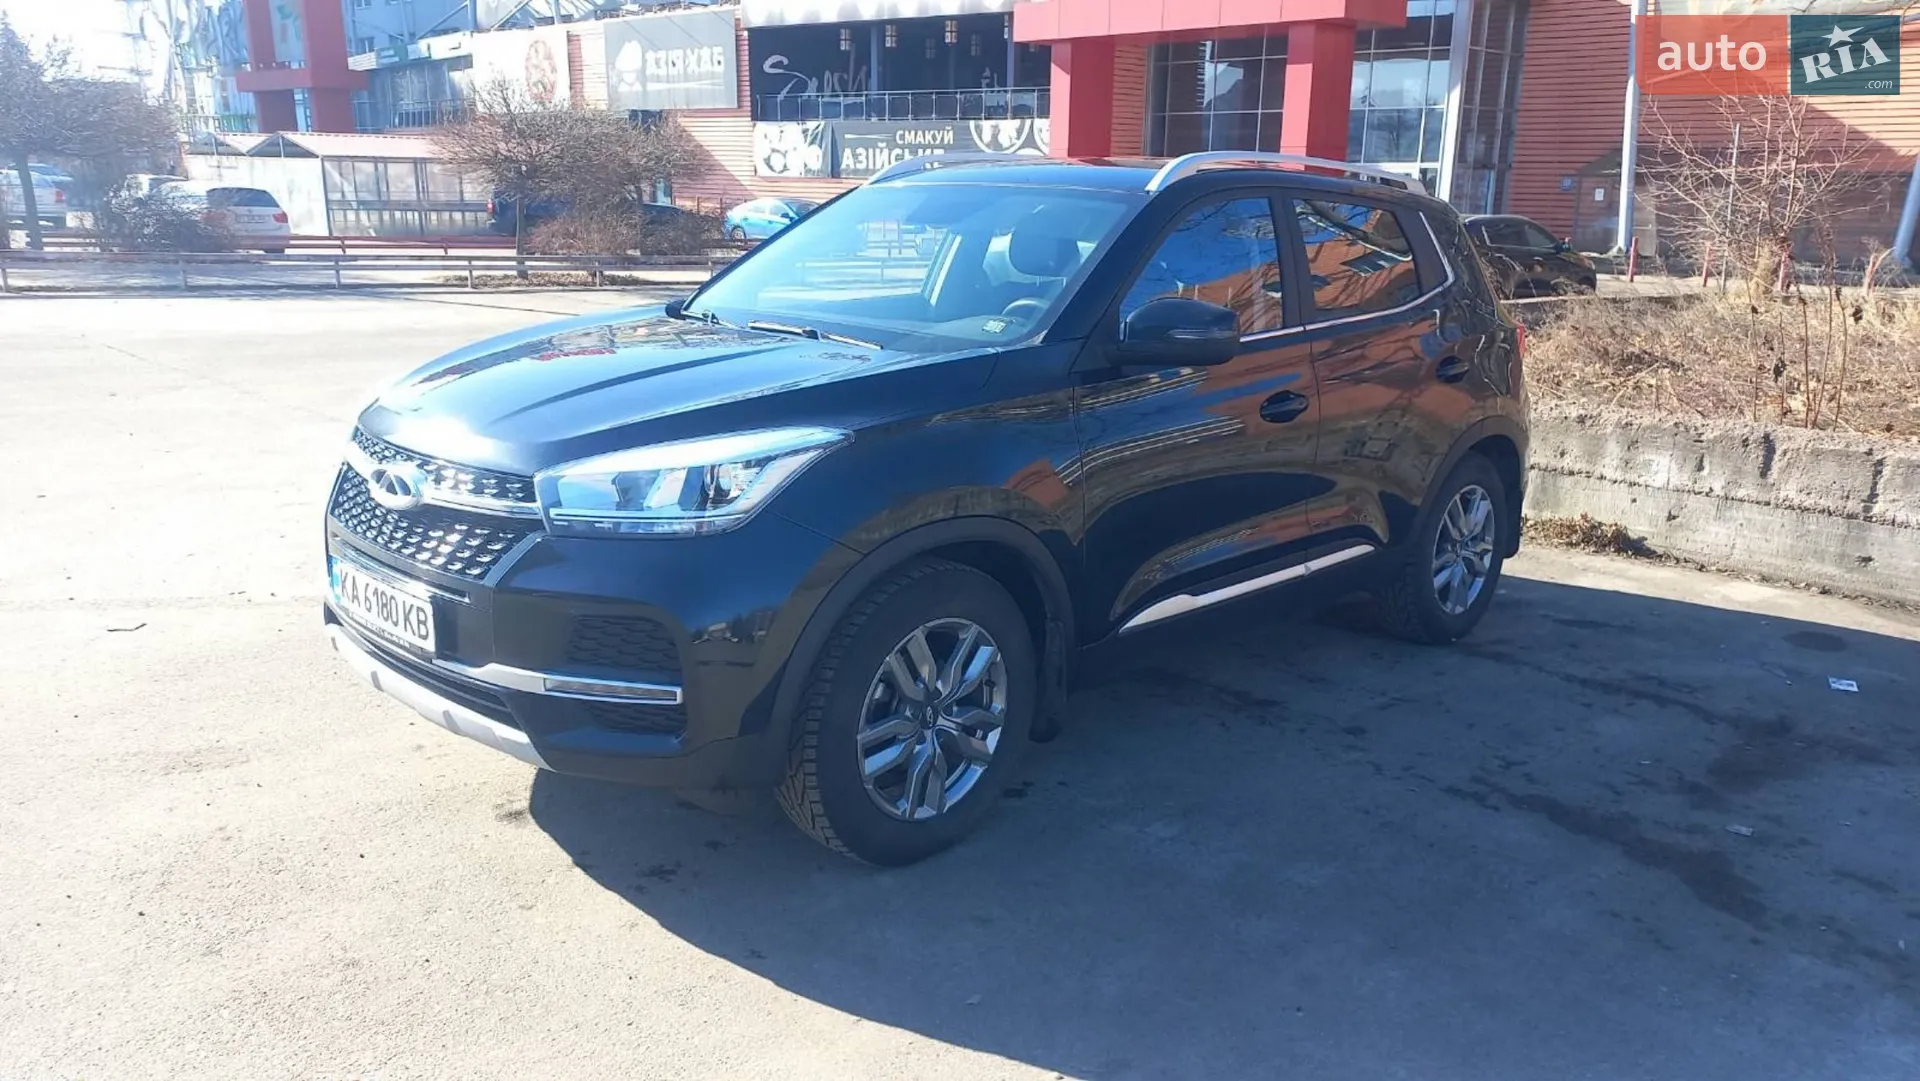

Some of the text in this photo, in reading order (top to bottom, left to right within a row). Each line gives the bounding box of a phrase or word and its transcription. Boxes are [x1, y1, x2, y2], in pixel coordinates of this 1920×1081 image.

[895, 126, 954, 145] СМАКУЙ
[340, 569, 361, 608] KA
[364, 582, 399, 627] 6180
[403, 600, 430, 641] KB
